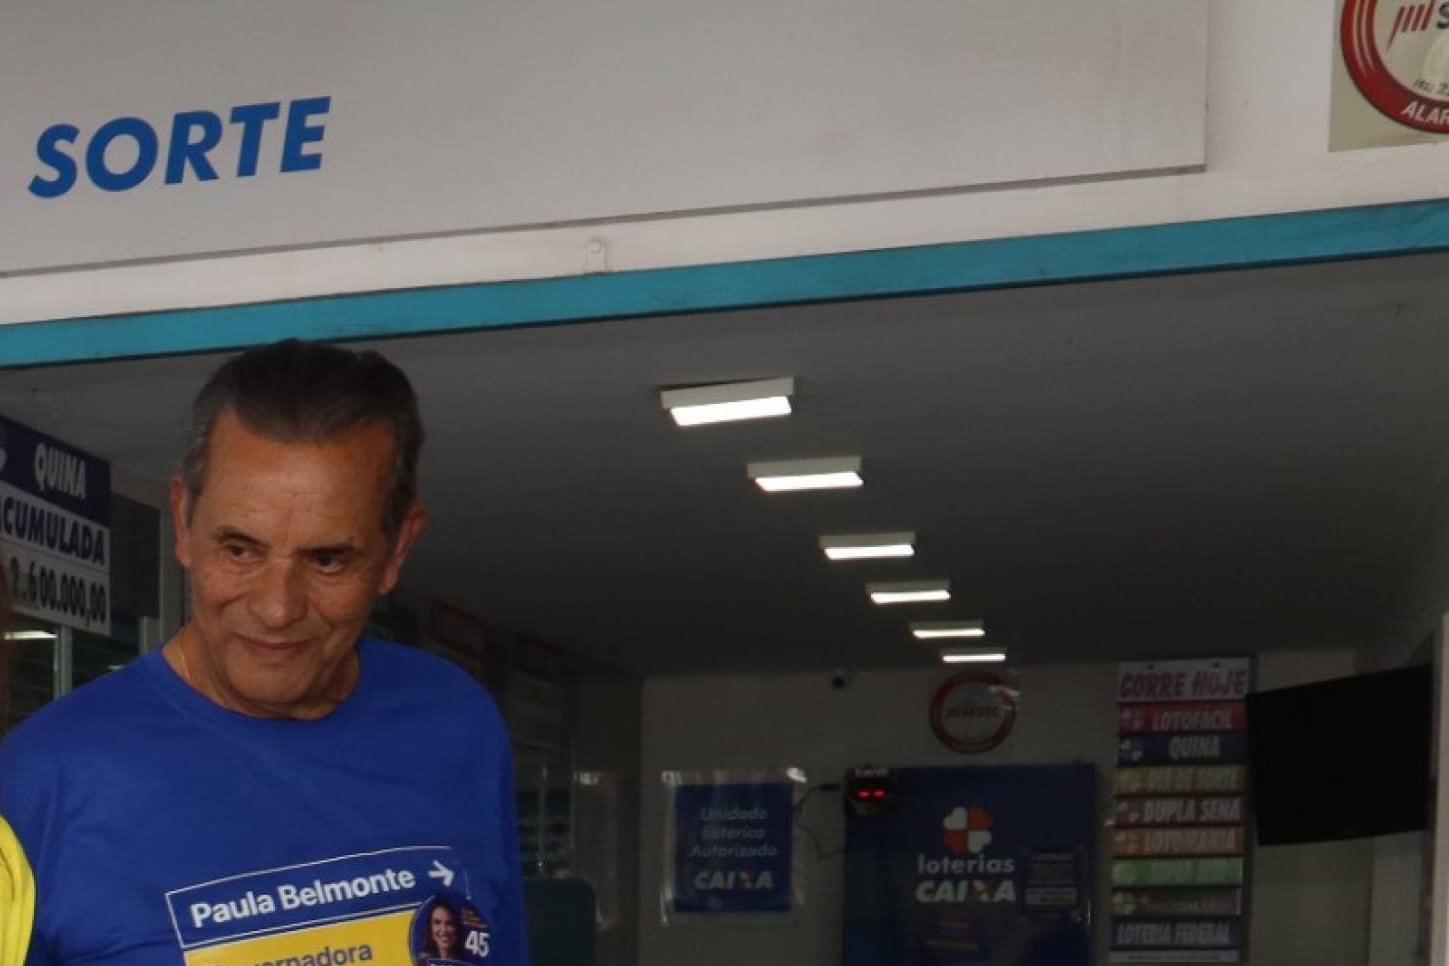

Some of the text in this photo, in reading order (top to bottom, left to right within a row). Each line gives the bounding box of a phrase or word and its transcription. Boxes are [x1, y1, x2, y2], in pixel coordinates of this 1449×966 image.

[29, 95, 332, 198] SORTE
[33, 442, 86, 500] QUINA
[1120, 671, 1246, 698] CORRE HOJE
[1169, 735, 1220, 760] QUINA
[918, 854, 1014, 875] loterias
[694, 868, 774, 890] CAIXA
[915, 879, 1016, 903] CAIXA
[190, 868, 416, 928] Paula Belmonte
[465, 930, 490, 957] 45
